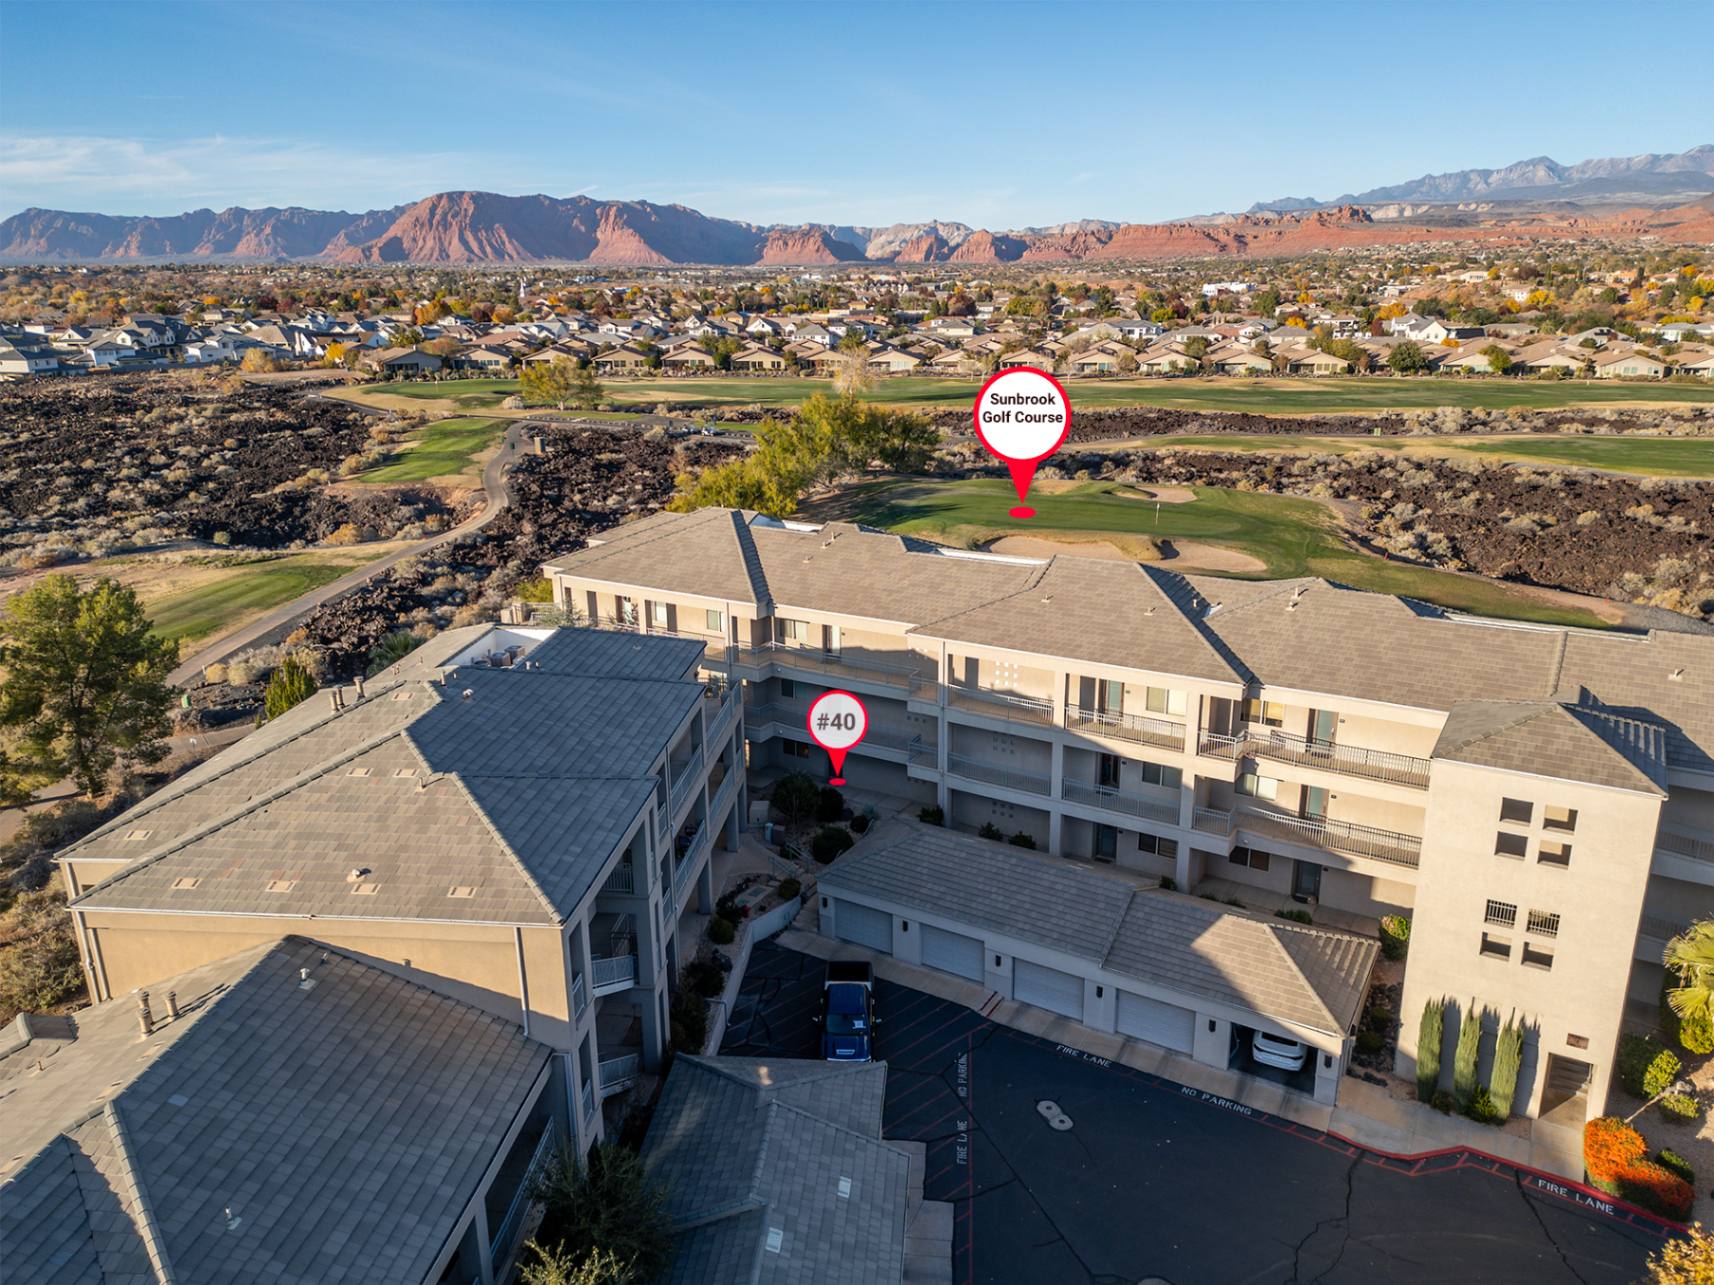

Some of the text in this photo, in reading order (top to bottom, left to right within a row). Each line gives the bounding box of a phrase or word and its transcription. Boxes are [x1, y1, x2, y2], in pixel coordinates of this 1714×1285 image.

[1056, 1044, 1113, 1068] FIRE LANE
[1181, 1086, 1252, 1116] NO PARKING
[956, 1145, 968, 1165] FIRE
[1538, 1179, 1614, 1215] FIRE LANE
